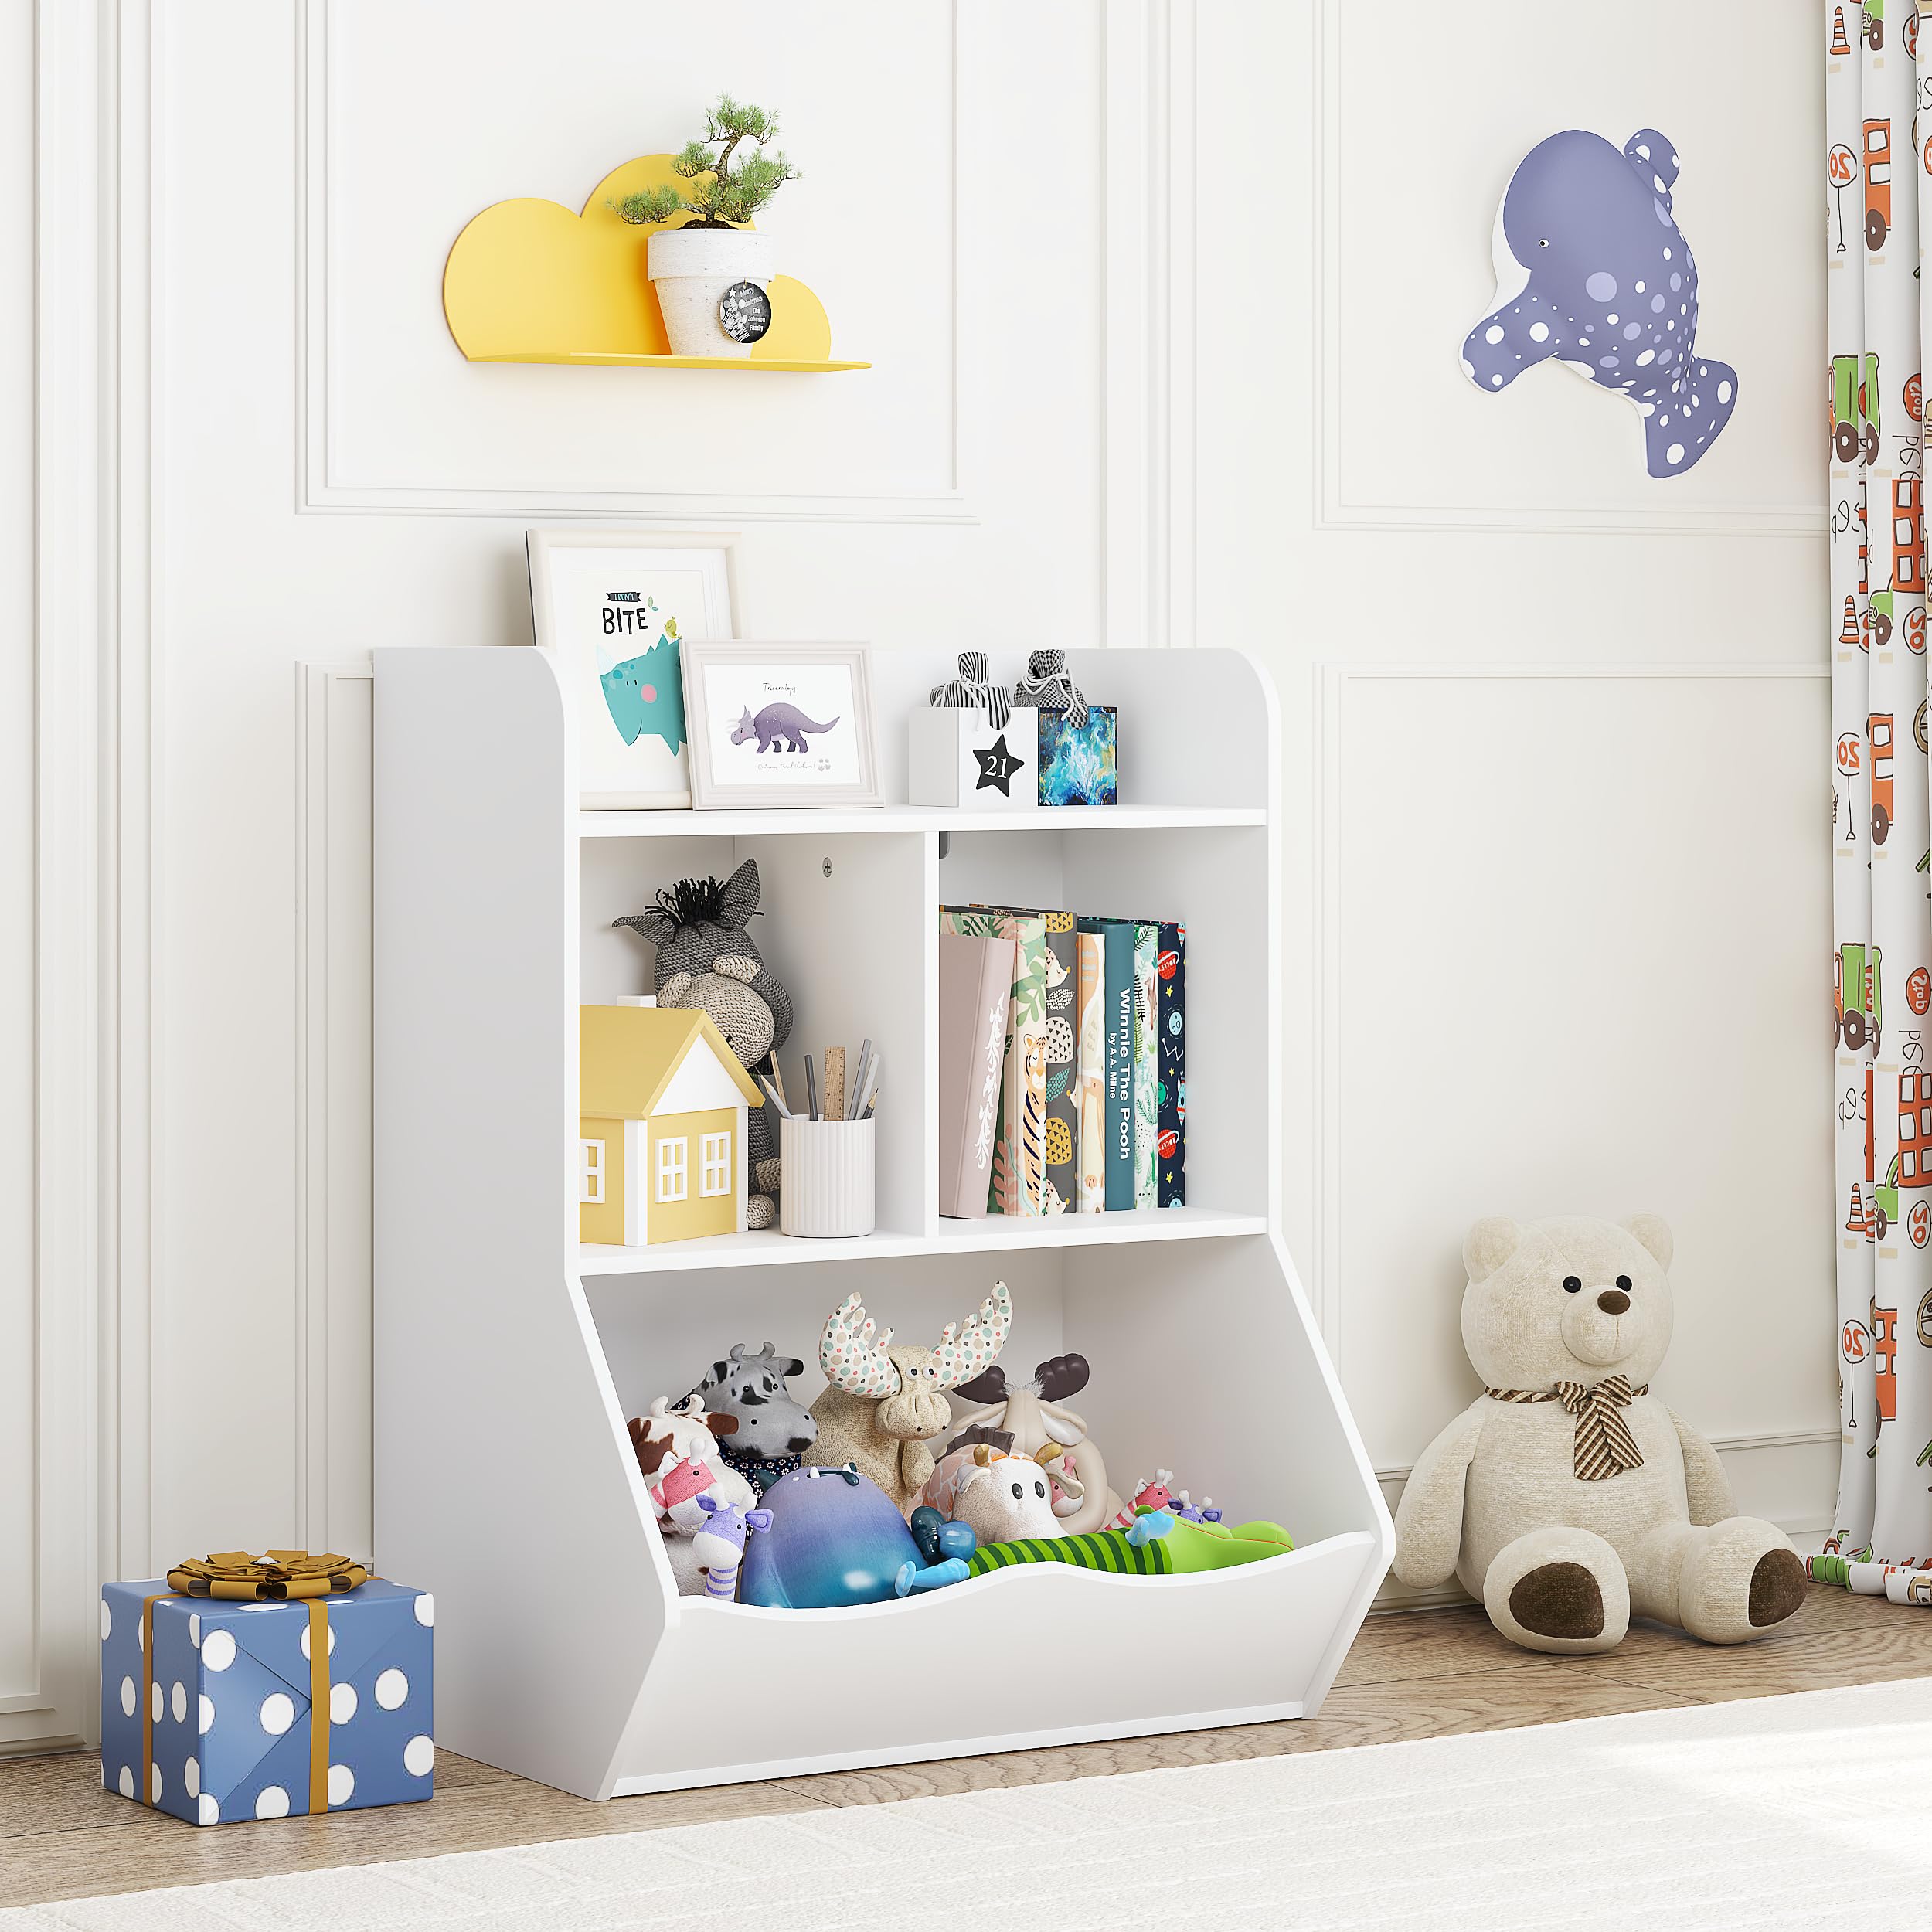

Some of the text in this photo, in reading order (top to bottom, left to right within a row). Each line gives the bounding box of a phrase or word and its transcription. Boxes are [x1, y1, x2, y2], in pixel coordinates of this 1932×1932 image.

[740, 287, 754, 297] Merry
[618, 592, 634, 600] DON'T
[603, 607, 648, 634] BITE
[763, 682, 796, 696] Triceratops
[985, 755, 1007, 779] 21
[1108, 1032, 1117, 1099] by A.A. Milne
[1120, 988, 1131, 1159] Winnie The Pooh
